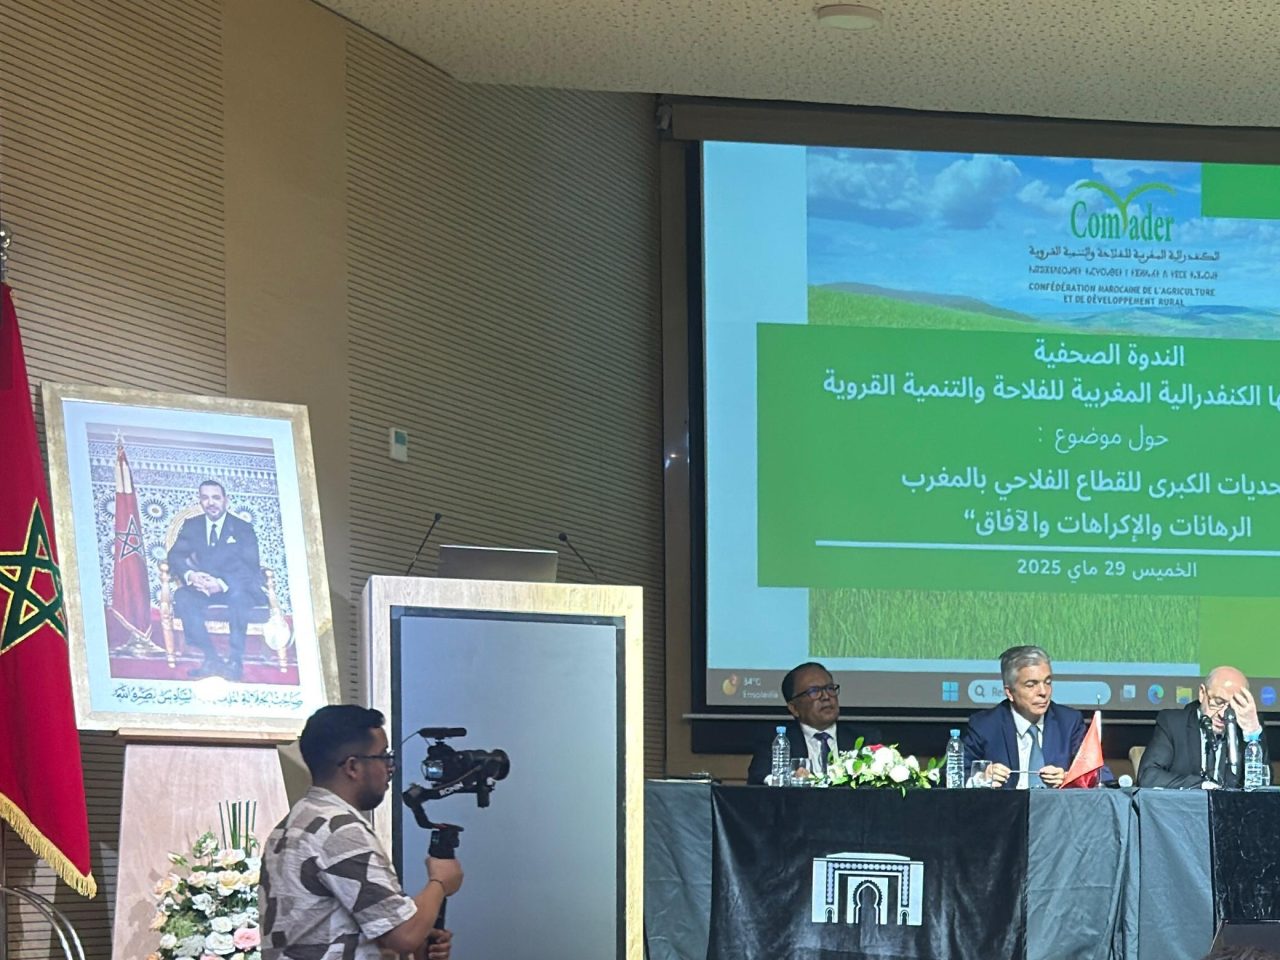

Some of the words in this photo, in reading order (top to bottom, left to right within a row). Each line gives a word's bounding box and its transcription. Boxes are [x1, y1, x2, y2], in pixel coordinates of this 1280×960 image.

[1063, 295, 1073, 303] ET
[1075, 295, 1085, 303] DE
[1158, 298, 1185, 307] RURAL
[1142, 286, 1152, 295] DE
[1034, 338, 1121, 368] الصحفية
[1127, 343, 1185, 371] الندوة
[822, 368, 896, 400] القروية
[902, 371, 985, 403] والتنمية
[992, 374, 1064, 401] للفلاحة
[1071, 376, 1151, 408] المغربية
[1158, 379, 1261, 411] الكنفدرالية
[1055, 426, 1122, 454] موضوع
[1128, 423, 1169, 452] حول
[901, 466, 987, 494] بالمغرب
[994, 468, 1069, 501] الفلاحي
[1075, 469, 1142, 501] للقطاع
[1148, 472, 1211, 499] الكبرى
[1056, 511, 1162, 542] والإكراهات
[1169, 514, 1252, 542] الرهانات
[1017, 558, 1061, 575] 2025
[1067, 559, 1098, 584] ماي
[1104, 560, 1126, 576] 29
[1132, 561, 1198, 581] الخميس
